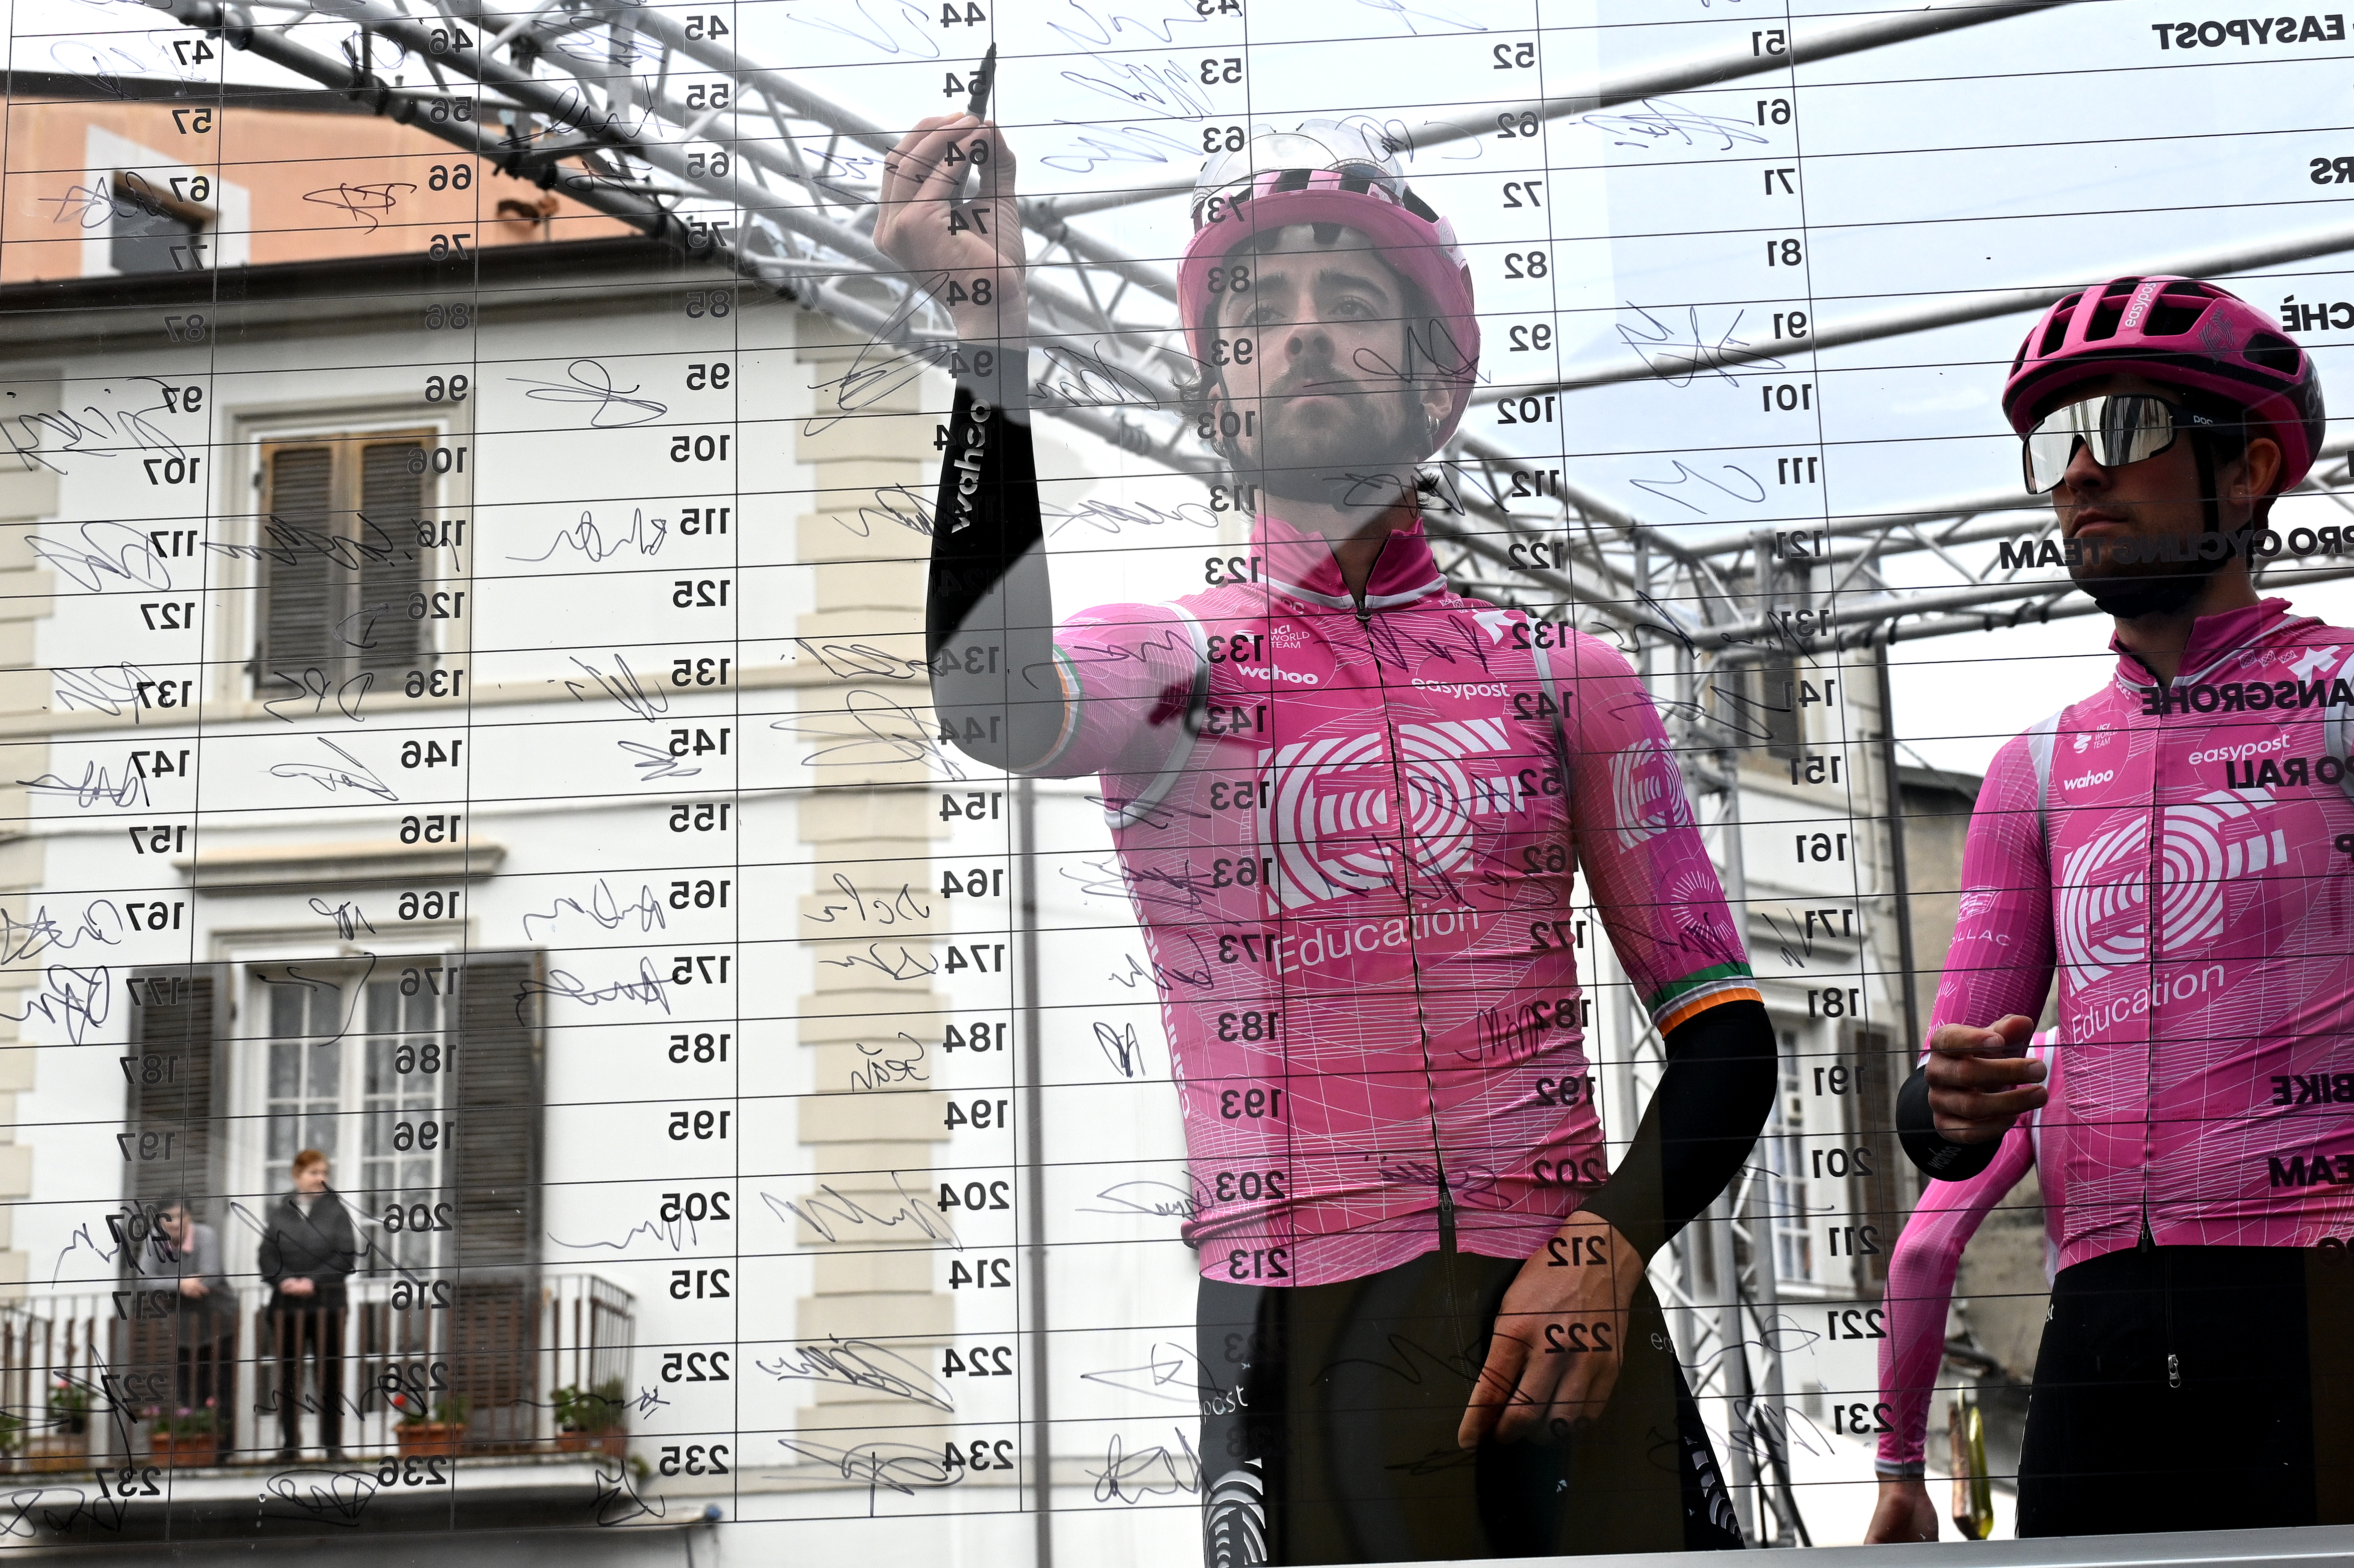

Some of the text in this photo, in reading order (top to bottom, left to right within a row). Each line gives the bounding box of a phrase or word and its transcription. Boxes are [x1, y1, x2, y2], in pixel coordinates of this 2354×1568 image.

[951, 399, 991, 532] wahoo
[1270, 631, 1310, 642] WORLD
[1236, 663, 1318, 684] wahoo
[1411, 676, 1511, 699] easypost
[2093, 737, 2111, 749] TEAM
[2188, 734, 2291, 765] easypost
[2064, 770, 2114, 790] wahoo
[1273, 902, 1479, 976] Education
[2072, 964, 2225, 1044] Education
[1200, 1384, 1248, 1425] post
